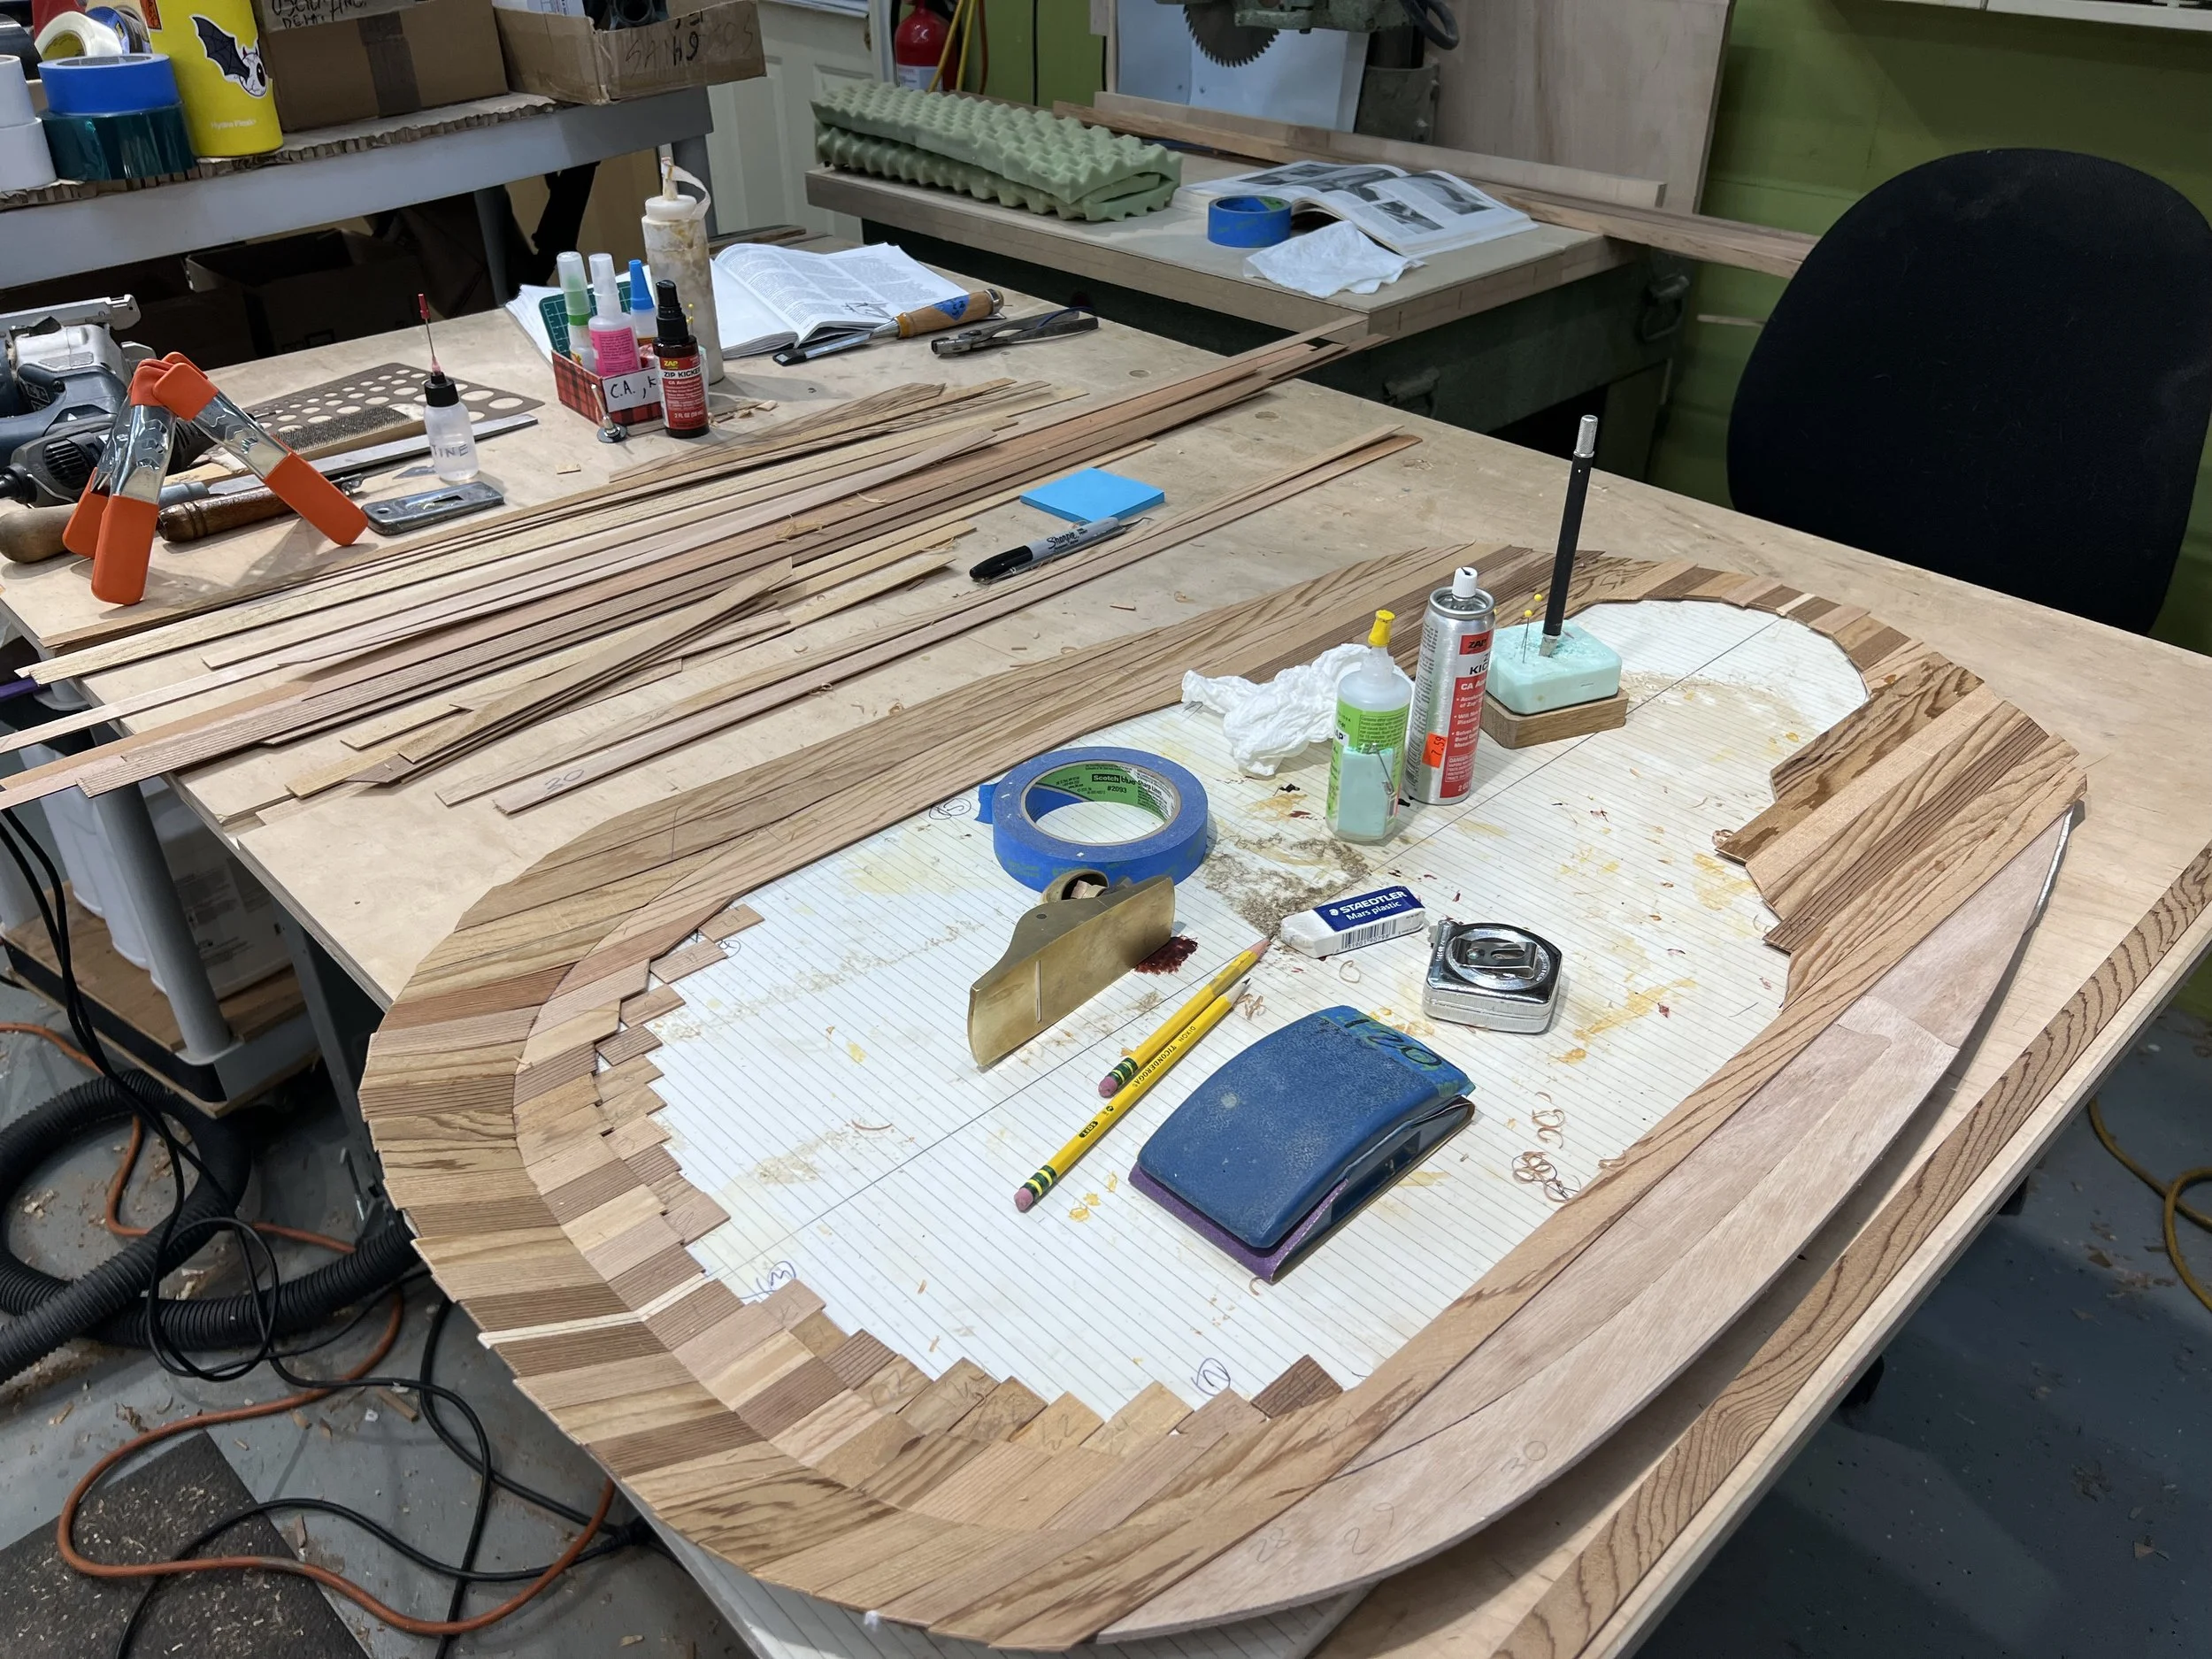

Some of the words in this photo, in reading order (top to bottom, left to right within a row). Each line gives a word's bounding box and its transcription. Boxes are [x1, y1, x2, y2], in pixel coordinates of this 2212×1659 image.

[1468, 638, 1487, 649] ZAP
[1093, 774, 1120, 783] Scotch
[1339, 890, 1408, 914] STAEDTLER
[1346, 909, 1371, 921] Mars
[1371, 901, 1402, 915] plastic
[1179, 1025, 1196, 1042] DIXON
[1344, 1018, 1443, 1066] 120
